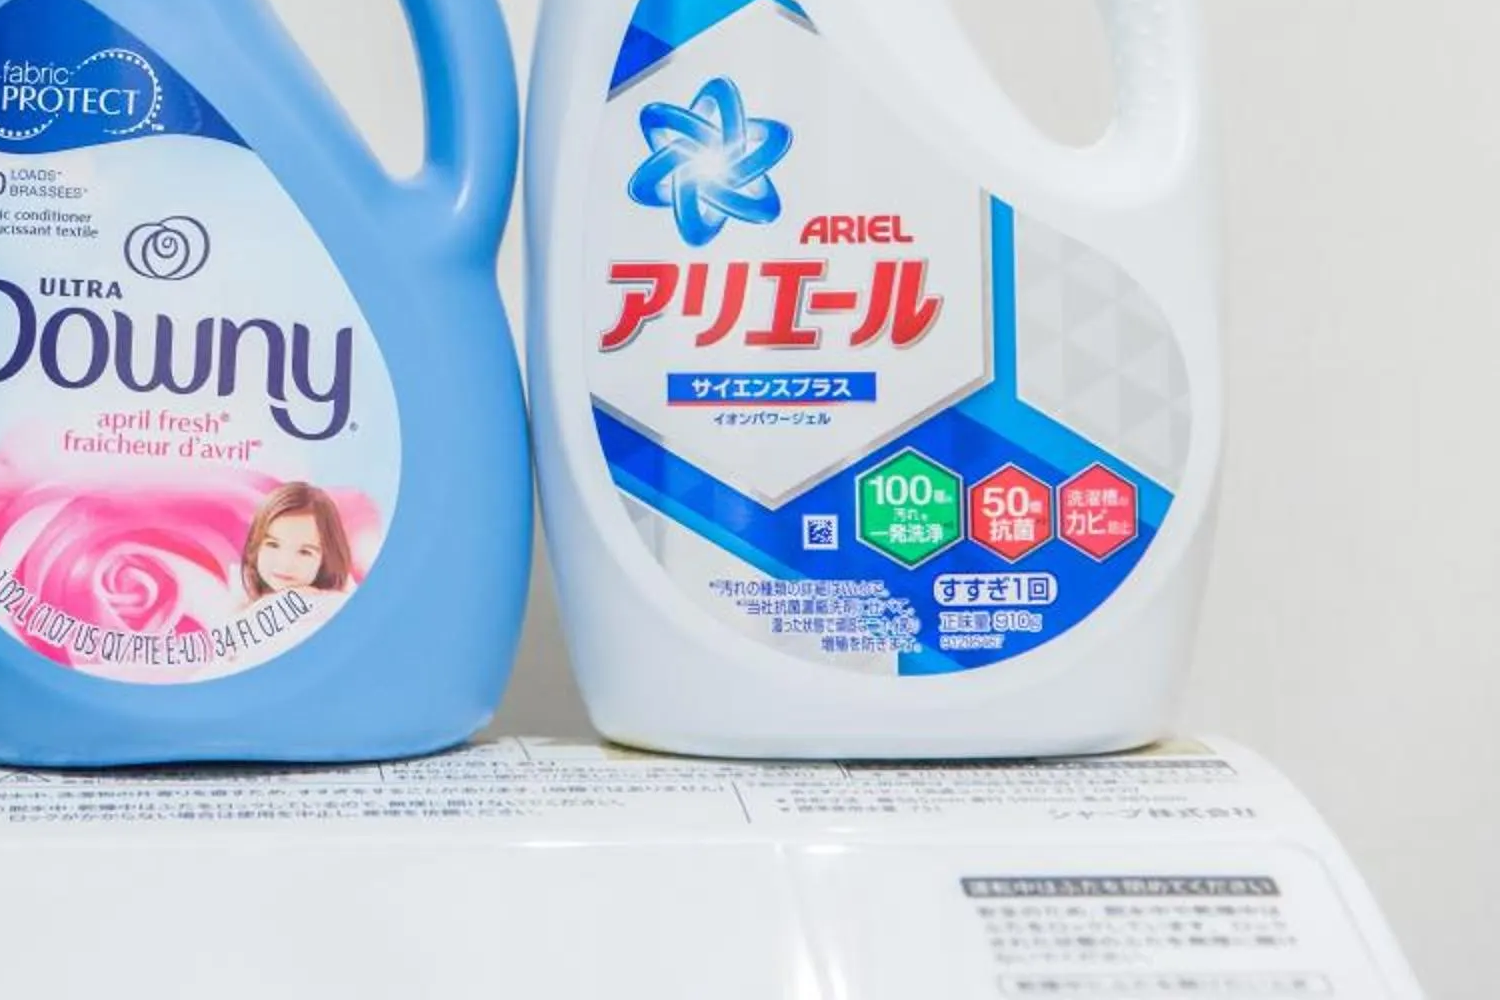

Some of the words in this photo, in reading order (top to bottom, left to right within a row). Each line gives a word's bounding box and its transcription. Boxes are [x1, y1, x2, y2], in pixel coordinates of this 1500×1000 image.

[3, 60, 69, 85] fabric
[1, 85, 139, 116] PROTECT
[14, 208, 92, 223] conditioner
[55, 224, 99, 239] textile
[800, 215, 914, 244] ARIEL
[39, 277, 124, 299] ULTRA
[600, 259, 944, 350] アリエール
[691, 378, 852, 398] サイエンスプラス
[97, 408, 151, 434] april
[713, 411, 831, 426] イオンパワージェル
[989, 518, 1035, 542] 抗菌
[939, 576, 1050, 602] すすぎ1回
[17, 596, 33, 622] L
[73, 624, 100, 654] US
[211, 625, 238, 658] 34
[236, 618, 262, 650] FL
[256, 605, 283, 638] OZ
[277, 588, 314, 625] LIQ.
